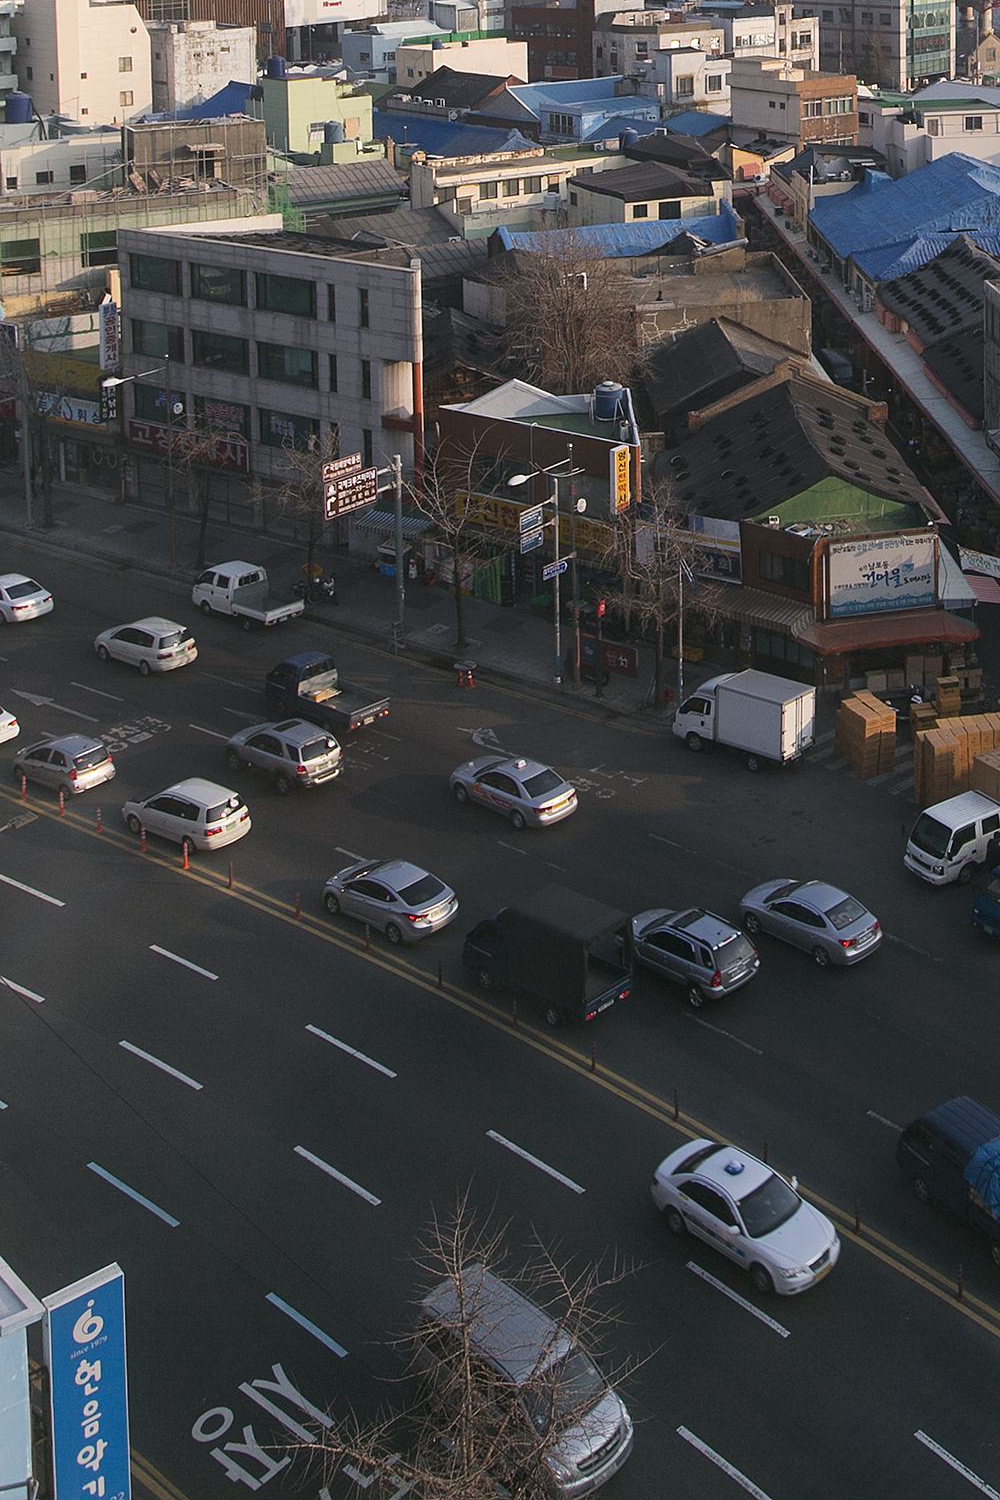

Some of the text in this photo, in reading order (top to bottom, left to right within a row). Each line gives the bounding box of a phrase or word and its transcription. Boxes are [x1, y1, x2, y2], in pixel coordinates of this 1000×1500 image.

[104, 316, 117, 362] 공인중개사
[617, 451, 628, 504] 영신천막사
[868, 560, 890, 571] 남포동
[967, 553, 991, 569] 신선한
[862, 568, 904, 589] 건어물
[70, 1335, 108, 1360] since 1979
[74, 1358, 108, 1498] 현음악기
